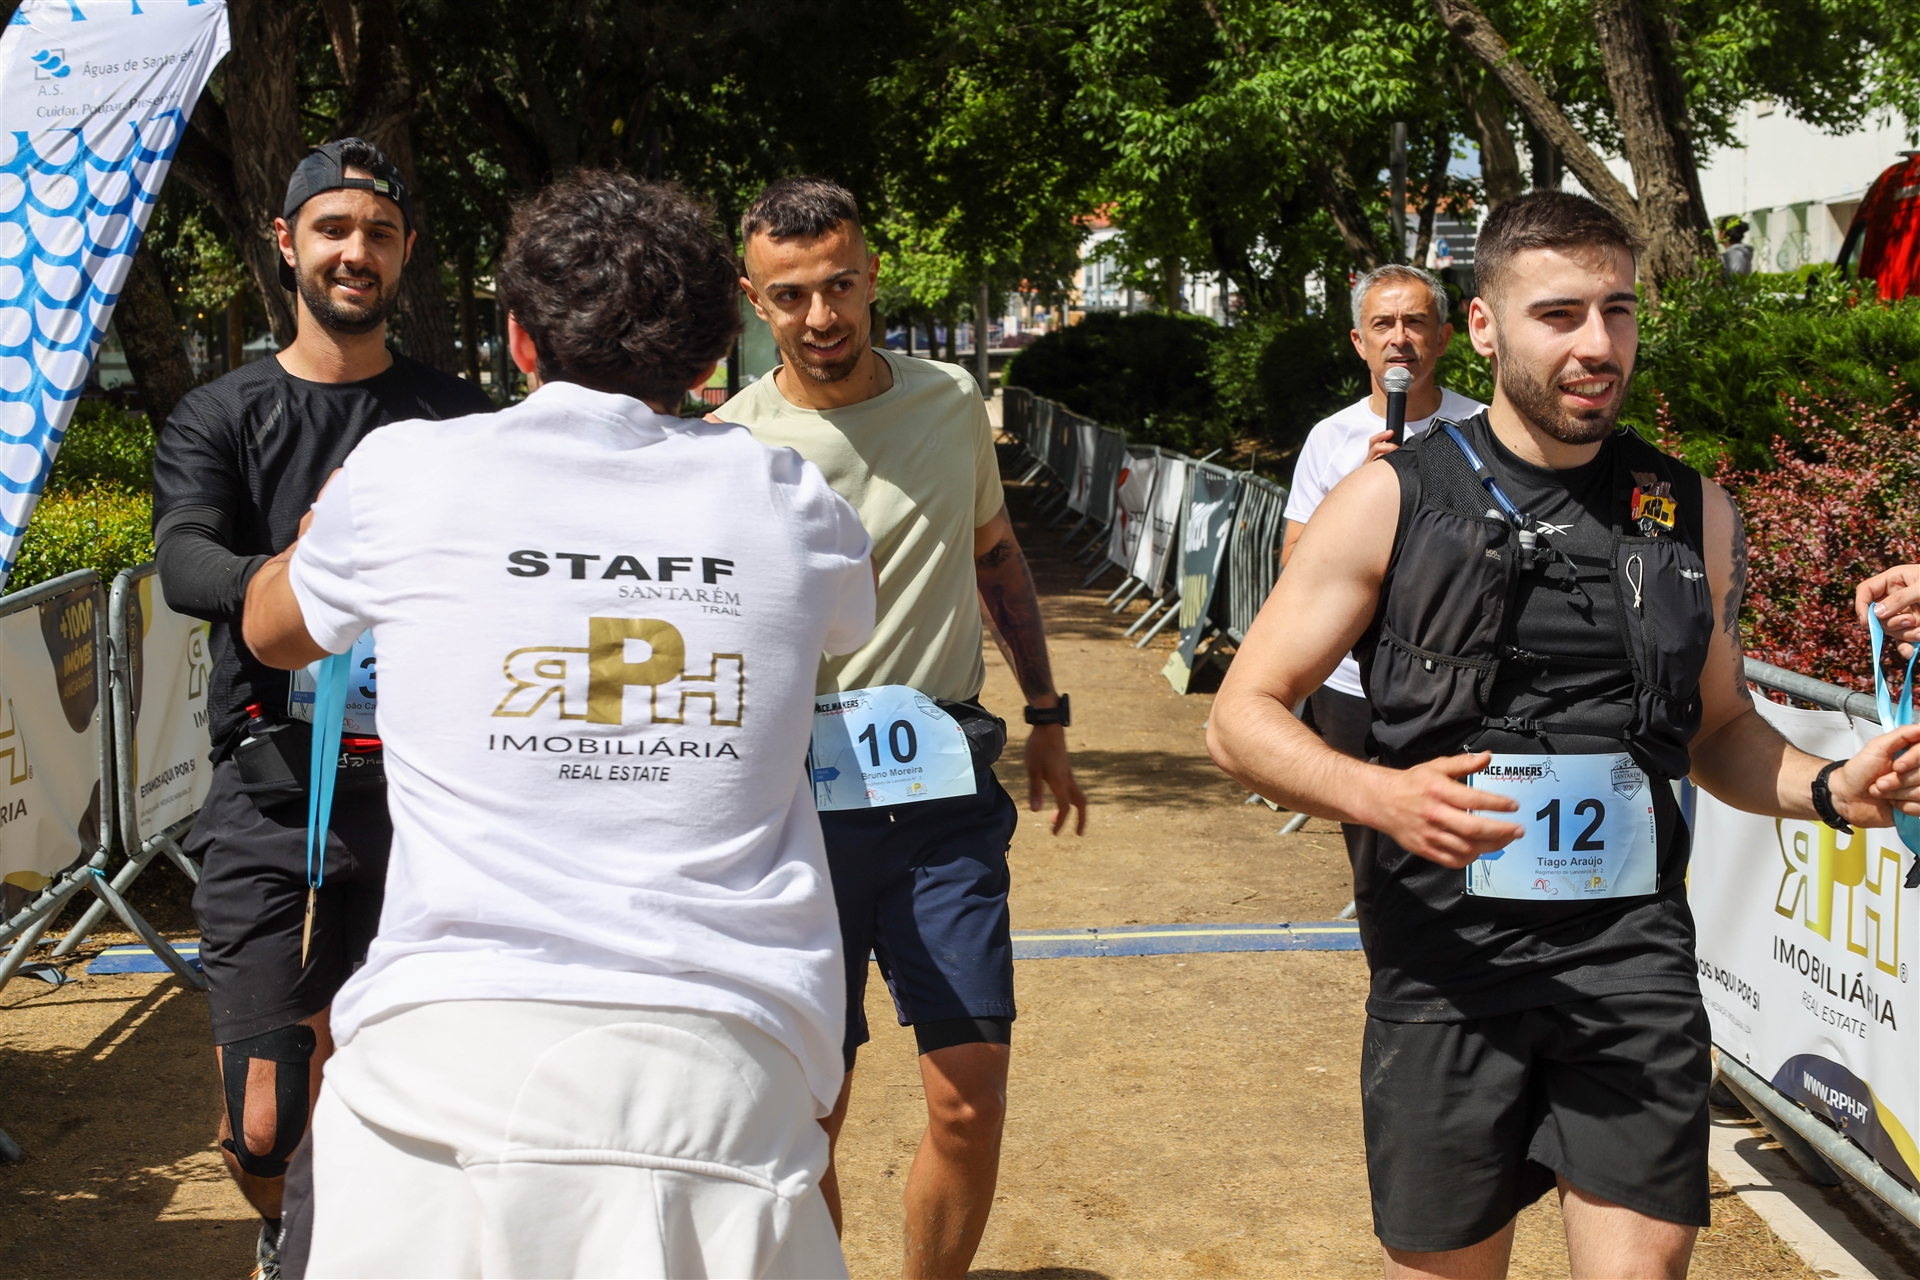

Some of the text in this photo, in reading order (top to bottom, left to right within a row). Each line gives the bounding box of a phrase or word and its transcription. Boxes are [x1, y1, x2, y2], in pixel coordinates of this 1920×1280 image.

[82, 49, 195, 78] Águas de Santaré
[37, 84, 64, 97] A.S.
[36, 106, 79, 118] Cuidar.
[506, 550, 735, 584] STAFF
[618, 585, 742, 606] SANTARÉM
[60, 598, 92, 640] +1000
[700, 605, 742, 617] TRAIL
[345, 702, 362, 710] oão
[488, 734, 741, 759] IMOBILIÁRIA
[858, 719, 917, 767] 10
[174, 760, 190, 778] POR
[558, 764, 671, 782] REAL ESTATE
[861, 766, 924, 781] Bruno Moreira
[1536, 798, 1606, 852] 12
[1536, 855, 1603, 869] Tiago Araújo
[1714, 966, 1737, 993] AQUI
[1737, 978, 1752, 1006] POR
[1752, 990, 1760, 1012] SI
[1773, 935, 1898, 1032] IMOBILIÁRIA
[1801, 990, 1867, 1039] REAL ESTATE
[1803, 1070, 1869, 1125] WWW.RPH.PT
